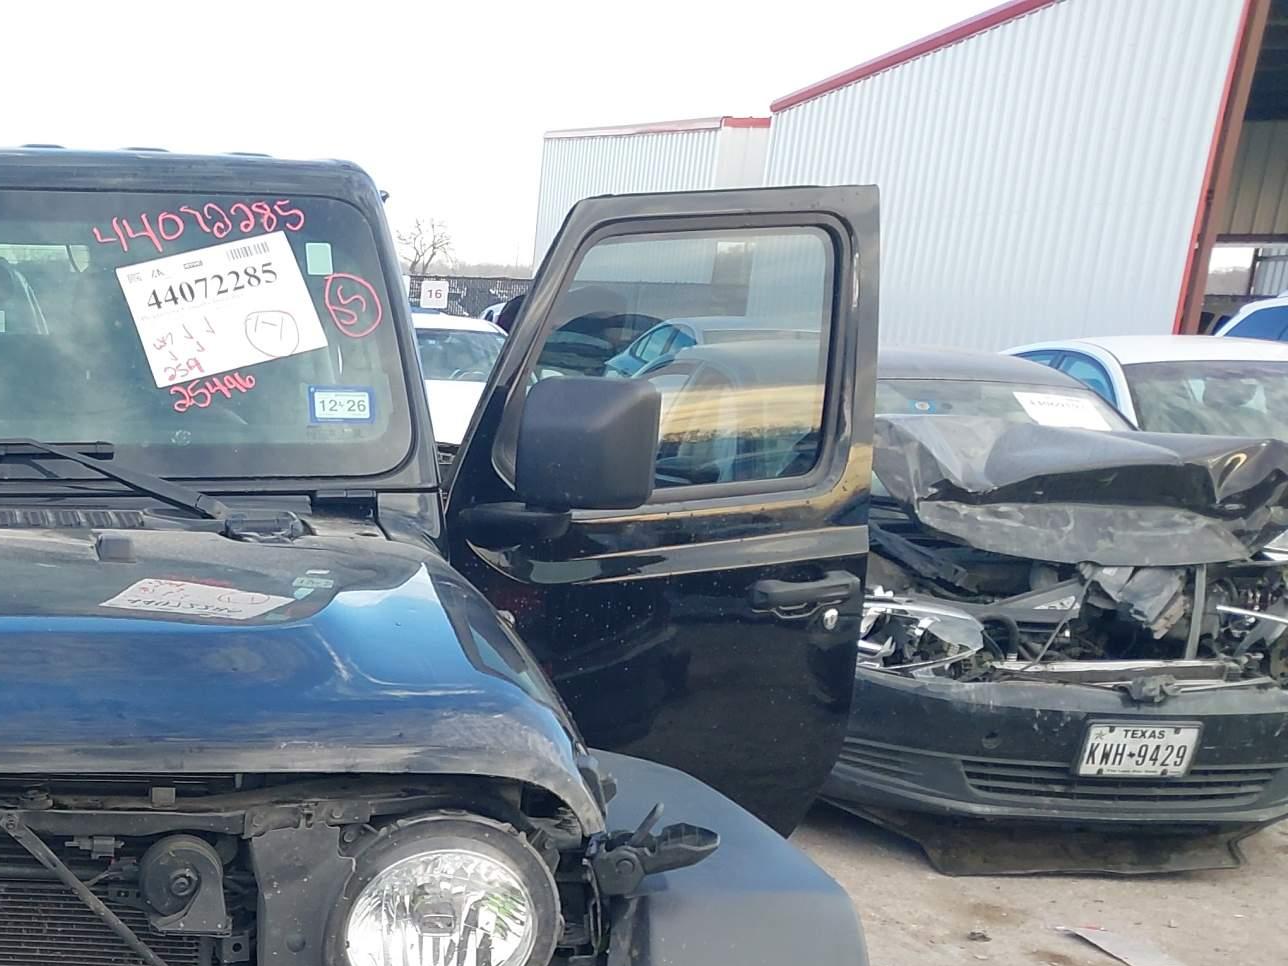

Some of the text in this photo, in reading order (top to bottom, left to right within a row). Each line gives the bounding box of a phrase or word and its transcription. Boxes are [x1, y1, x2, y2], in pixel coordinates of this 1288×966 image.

[92, 200, 305, 252] 44072285
[147, 262, 278, 310] 44072285
[427, 289, 442, 299] 16
[170, 372, 257, 413] 25496
[1123, 728, 1166, 740] TEXAS
